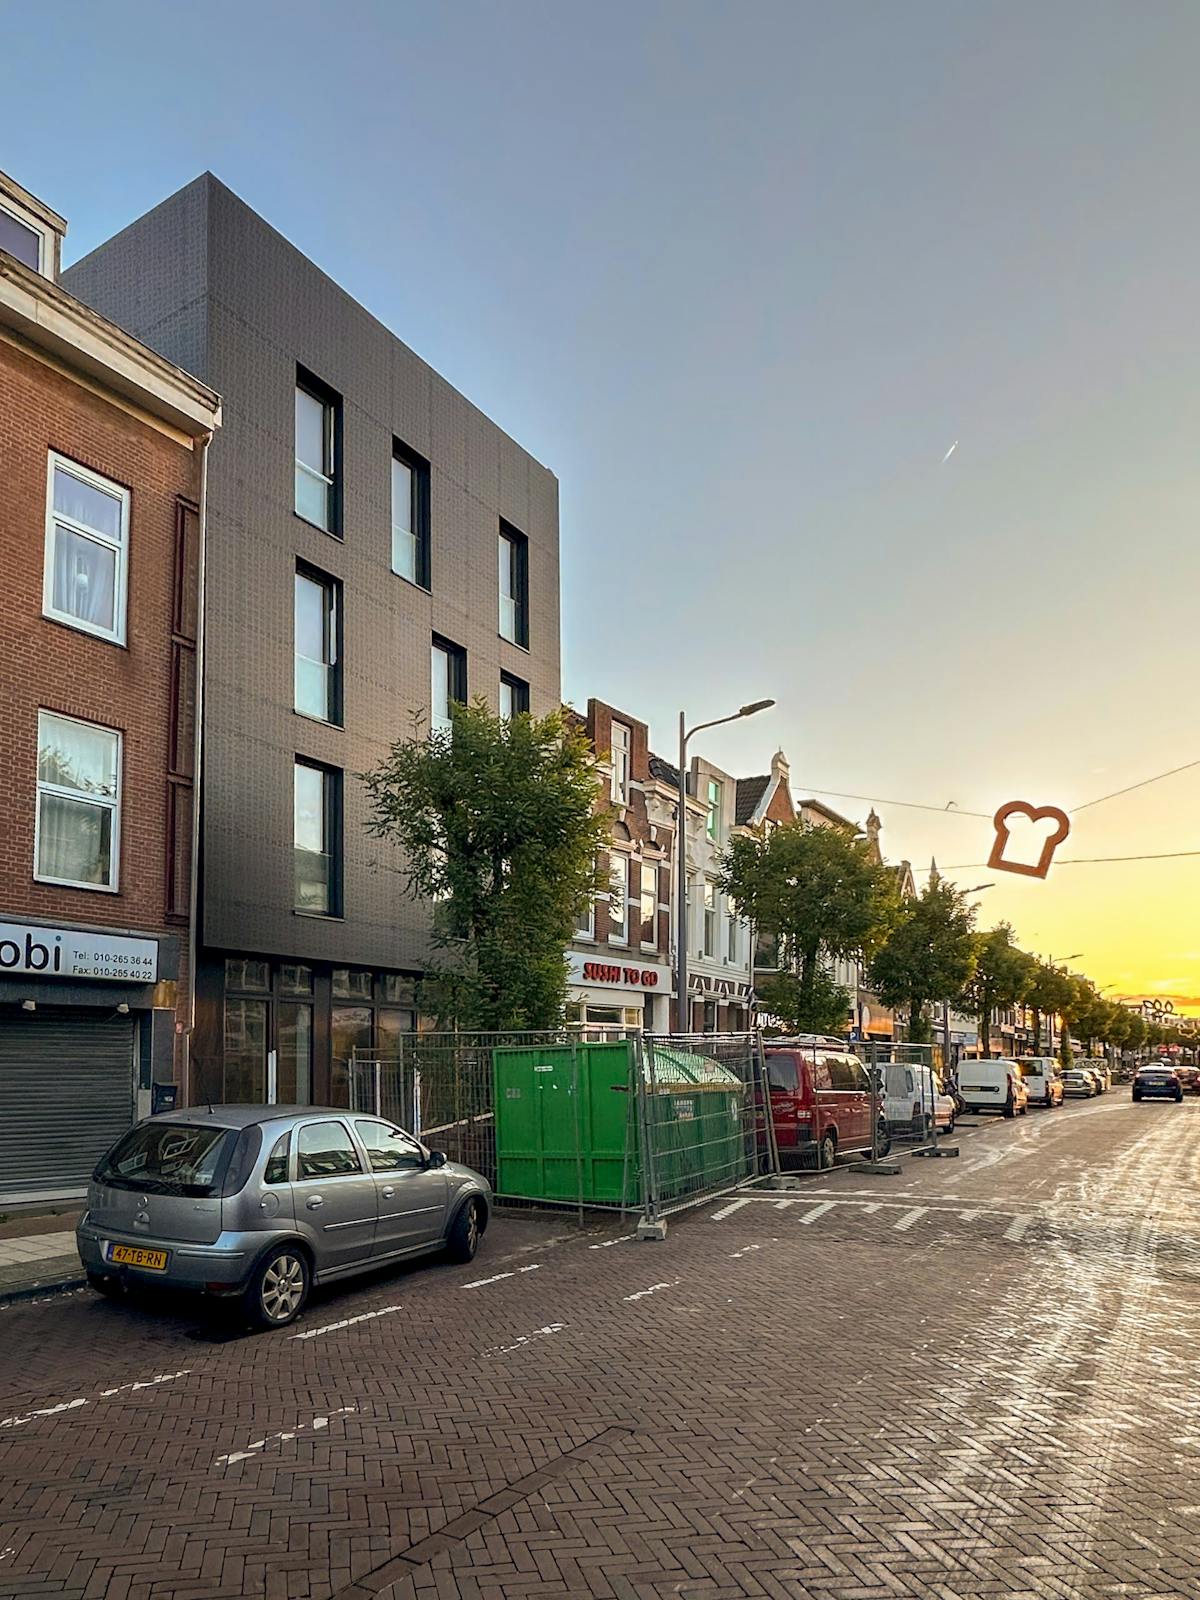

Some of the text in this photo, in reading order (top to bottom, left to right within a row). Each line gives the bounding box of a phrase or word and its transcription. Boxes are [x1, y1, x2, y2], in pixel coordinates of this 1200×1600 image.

[73, 950, 153, 966] Tel: 010-265 36 44
[72, 965, 153, 980] Fax: 010-265 40 22
[583, 962, 658, 987] SUSHI TO GO
[116, 1247, 162, 1266] 47-TB-RN
